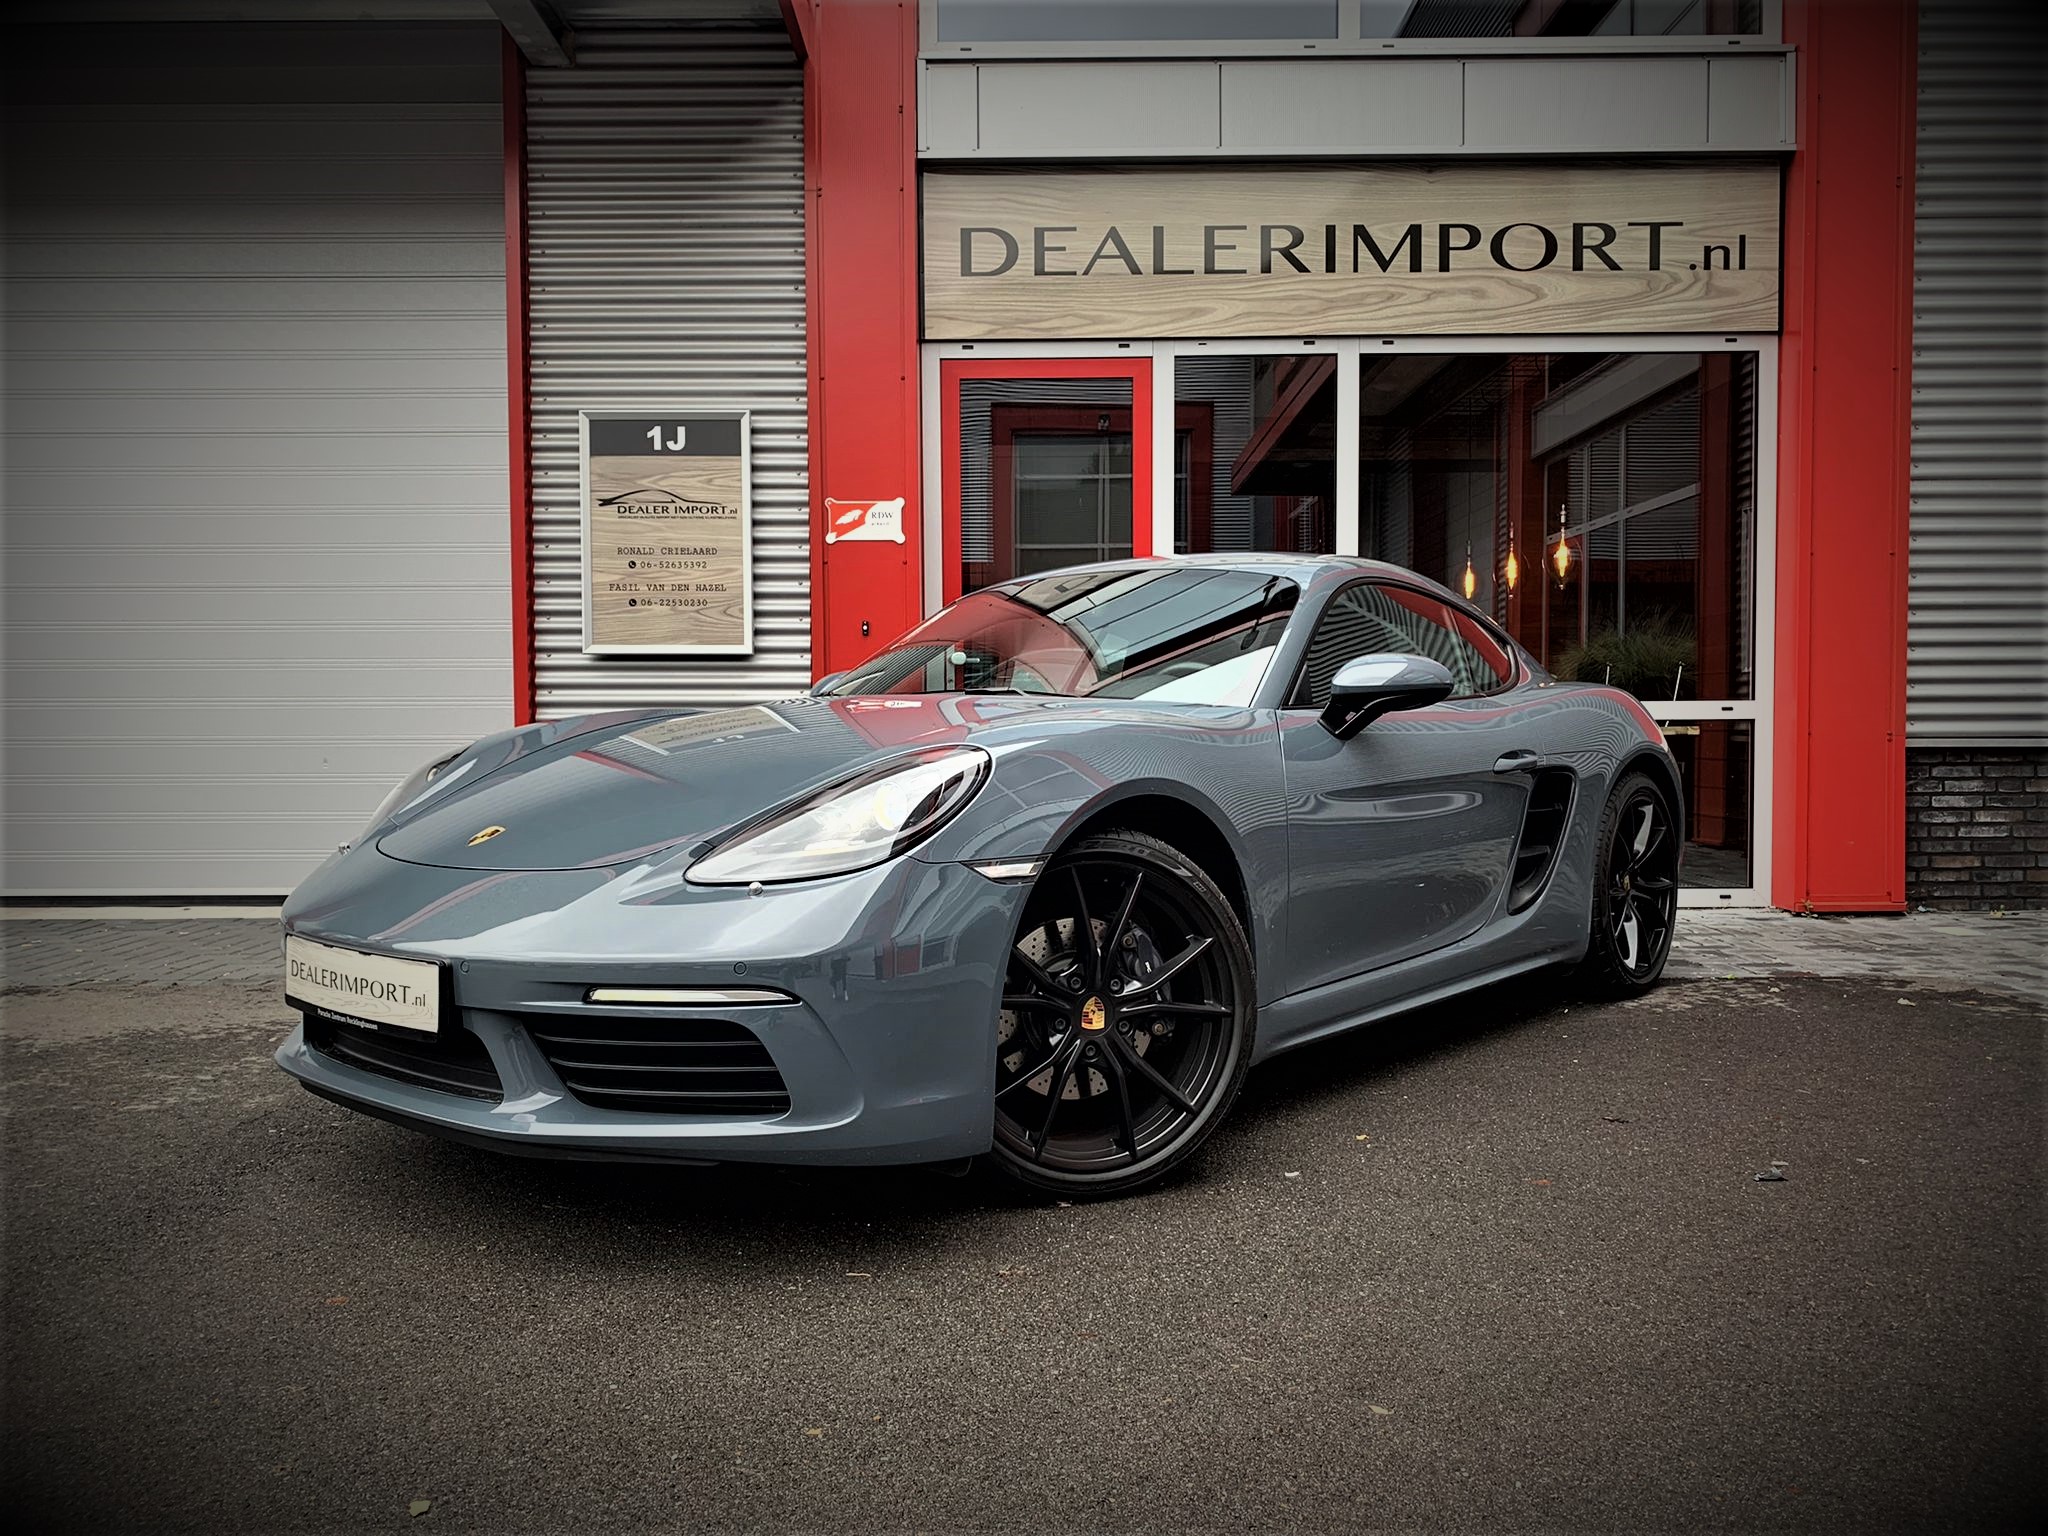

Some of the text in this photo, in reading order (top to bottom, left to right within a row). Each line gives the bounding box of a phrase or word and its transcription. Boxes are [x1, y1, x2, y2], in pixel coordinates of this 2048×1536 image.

[959, 220, 1748, 277] DEALERIMPORT.nl
[647, 425, 686, 451] 1J
[617, 505, 738, 515] DEALER IMPORT.nl
[871, 511, 893, 519] RDW
[617, 547, 718, 556] RONALD CRIELAARD
[640, 560, 707, 569] 06-52635392
[609, 583, 727, 592] FASIL VAN DEN HAZEL
[640, 598, 708, 607] 06-22530230
[291, 959, 426, 1007] DEALERIMPORT.nl
